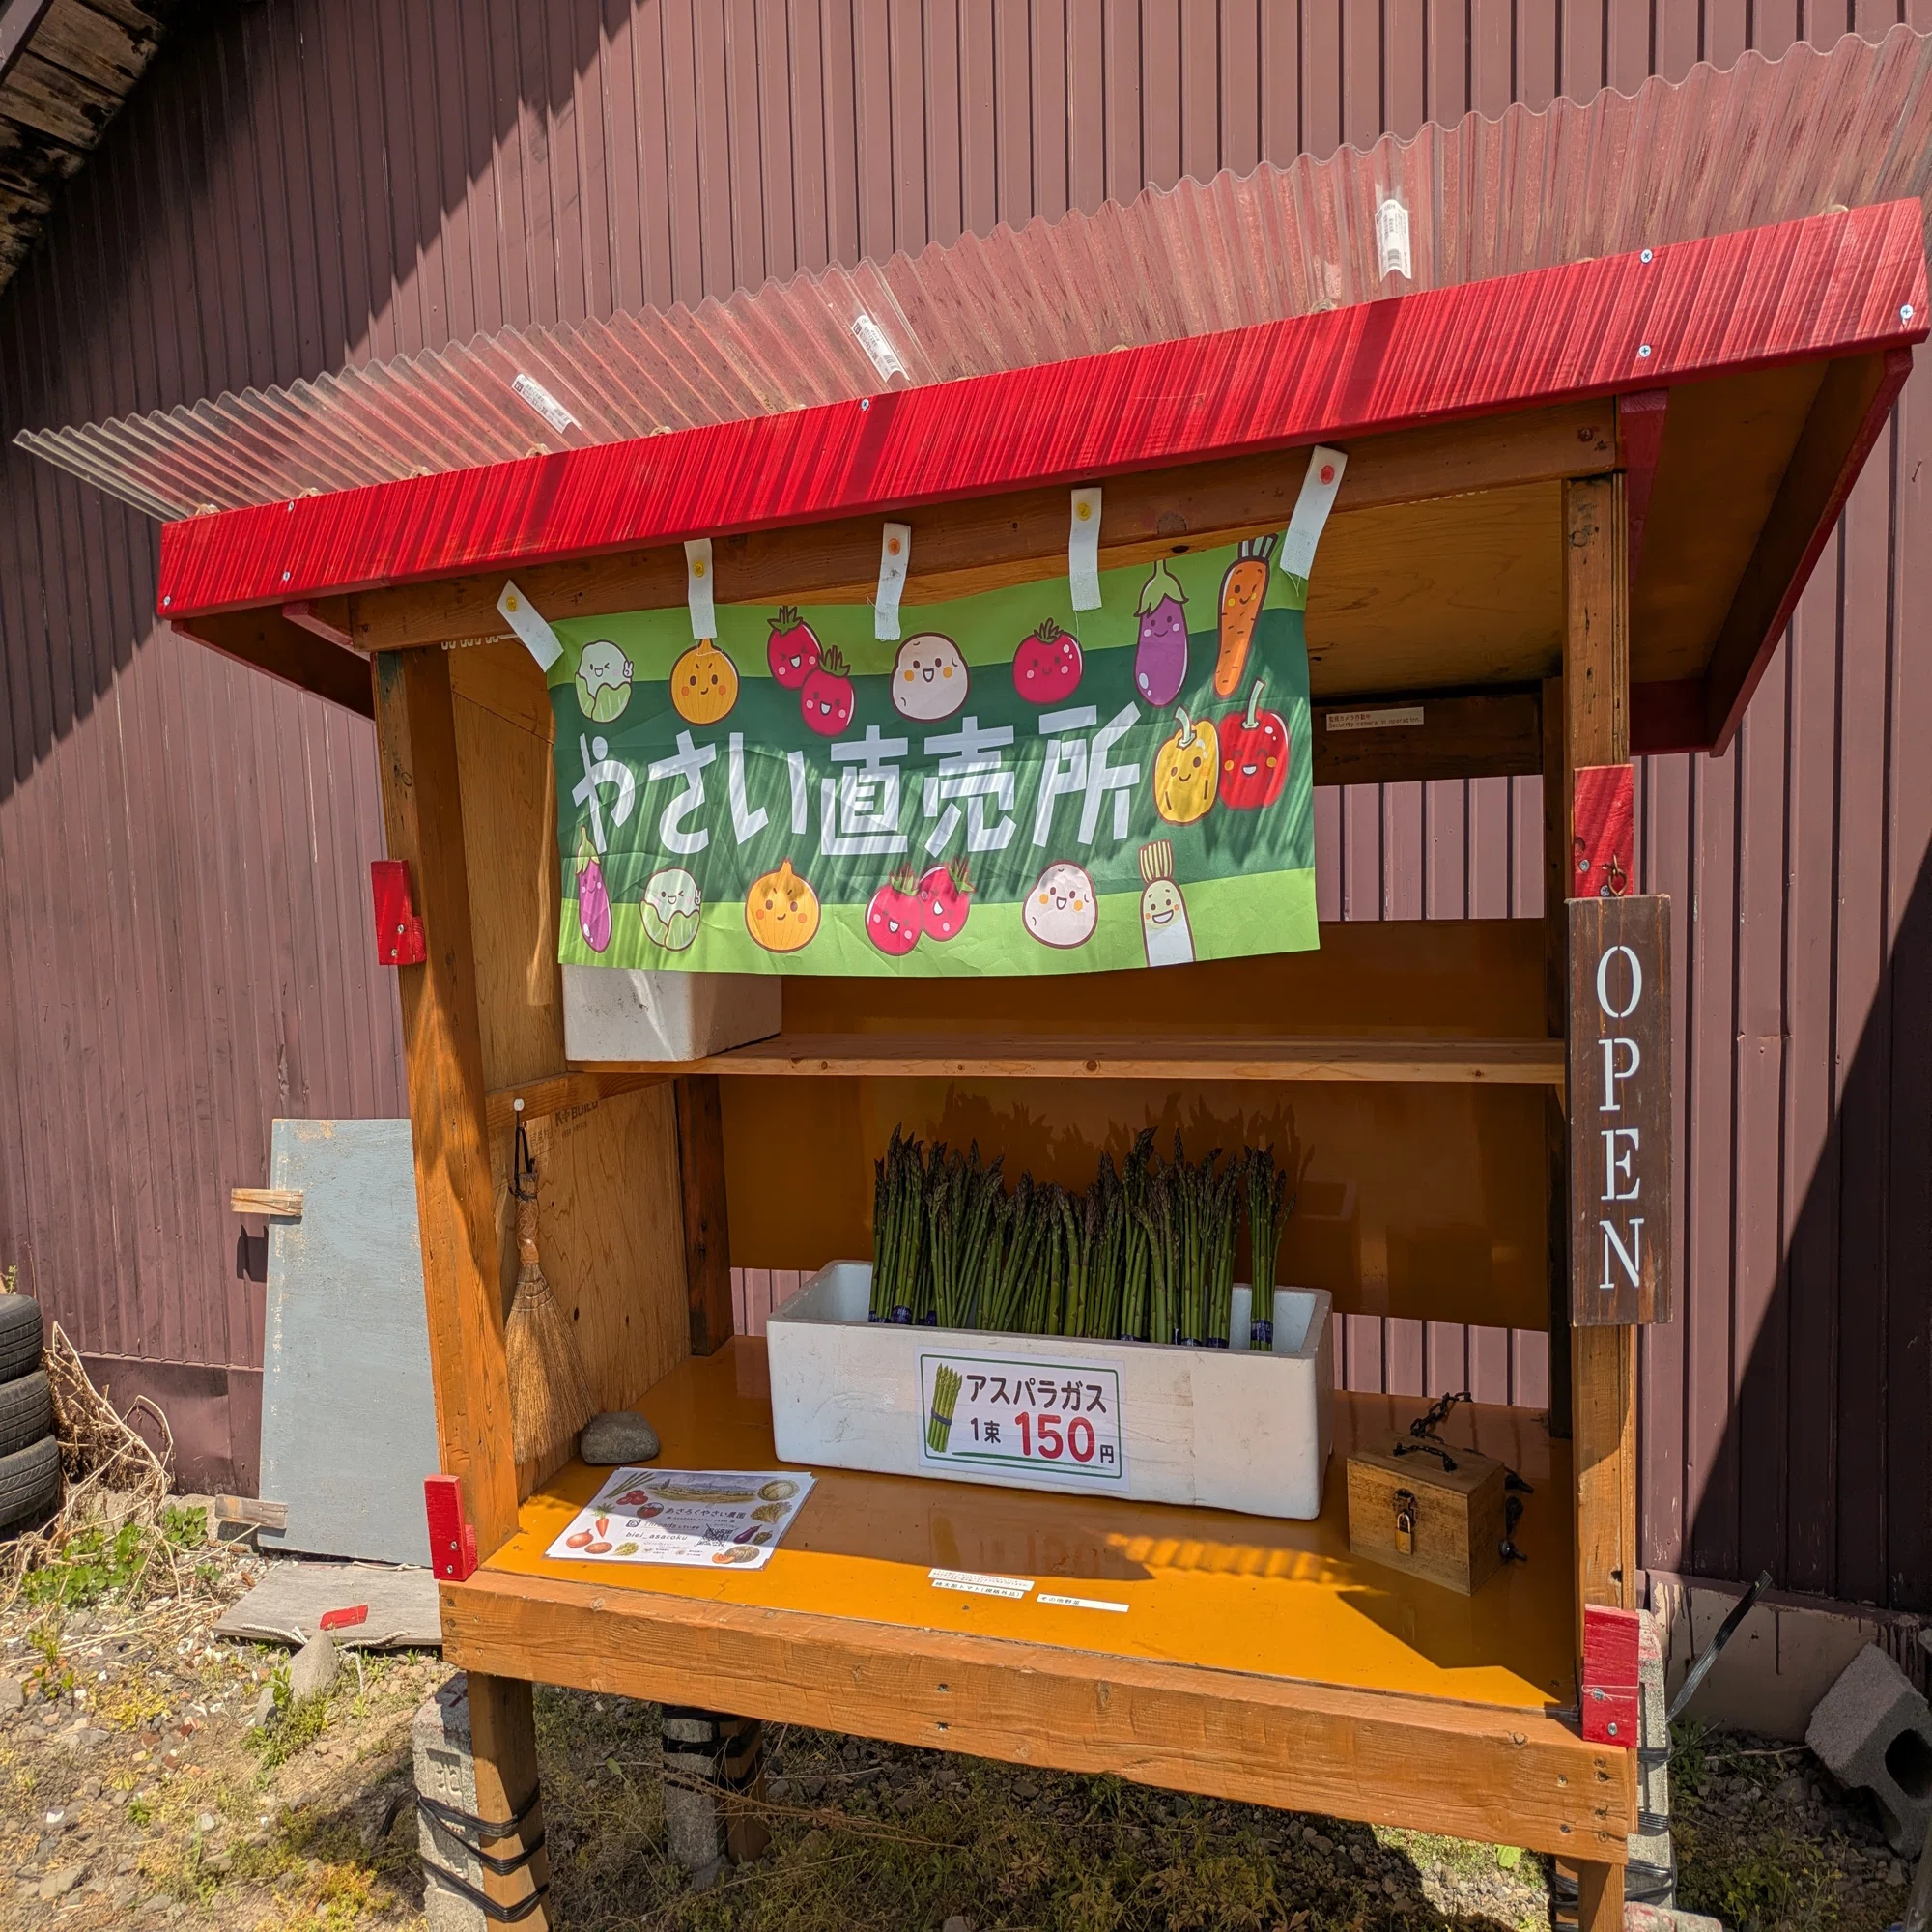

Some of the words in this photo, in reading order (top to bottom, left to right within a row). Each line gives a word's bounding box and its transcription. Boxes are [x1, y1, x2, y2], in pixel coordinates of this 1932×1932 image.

[572, 701, 1141, 858] やさい直売所
[1596, 946, 1644, 1290] OPEN
[966, 1374, 1107, 1414] アスパラガス
[970, 1417, 1002, 1444] 1束
[1014, 1411, 1114, 1464] 150円
[625, 1531, 688, 1541] biei_asaroku
[665, 1507, 747, 1520] あさろくやさい農園
